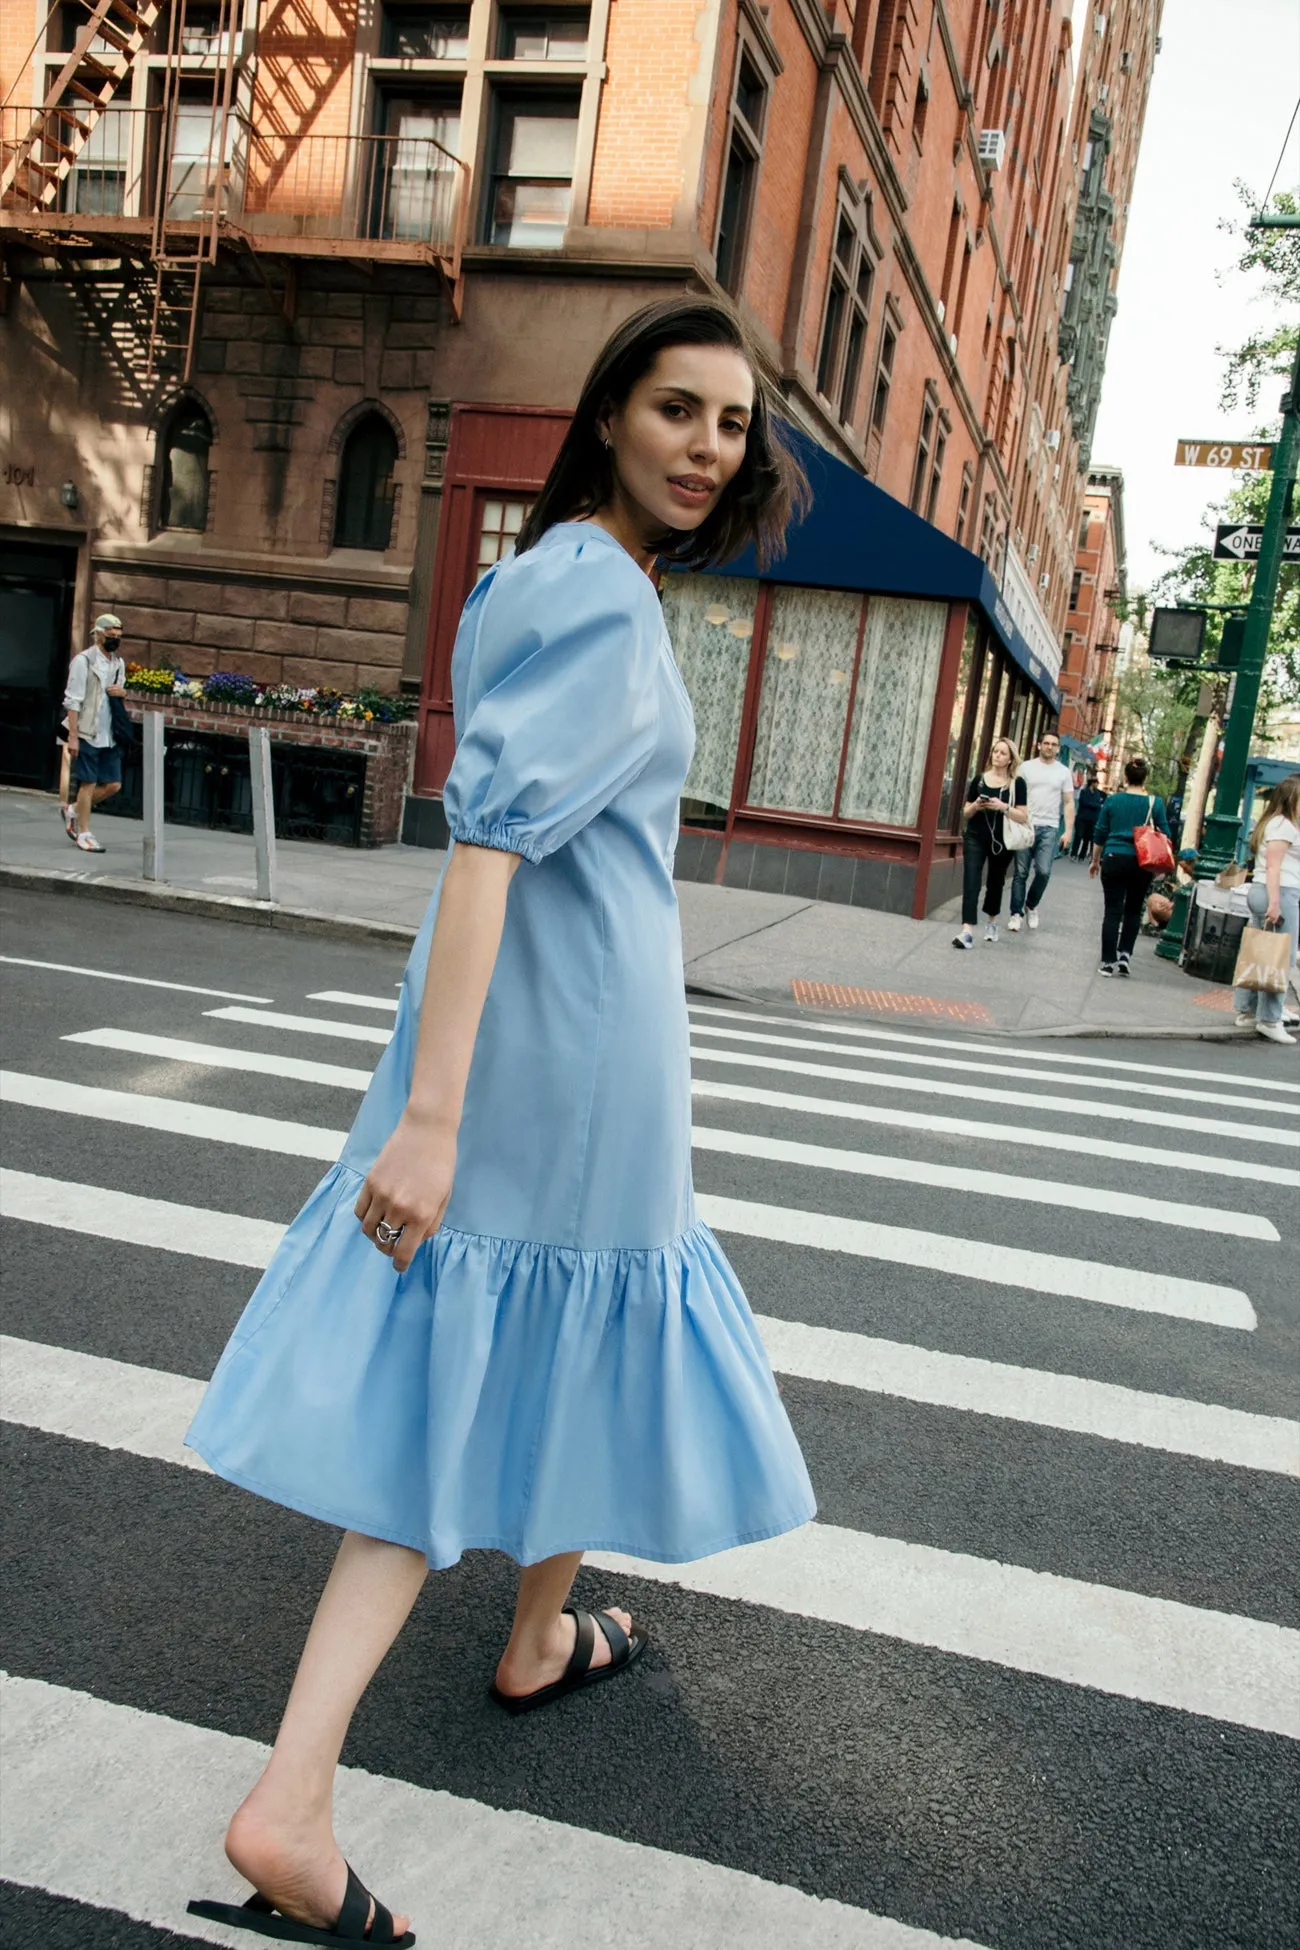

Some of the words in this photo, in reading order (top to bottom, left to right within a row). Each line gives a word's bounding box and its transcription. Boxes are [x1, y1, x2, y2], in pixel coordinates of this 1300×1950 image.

[1184, 445, 1200, 466] W
[1206, 446, 1233, 467] 69
[1239, 448, 1265, 469] ST
[1232, 535, 1263, 550] ONE
